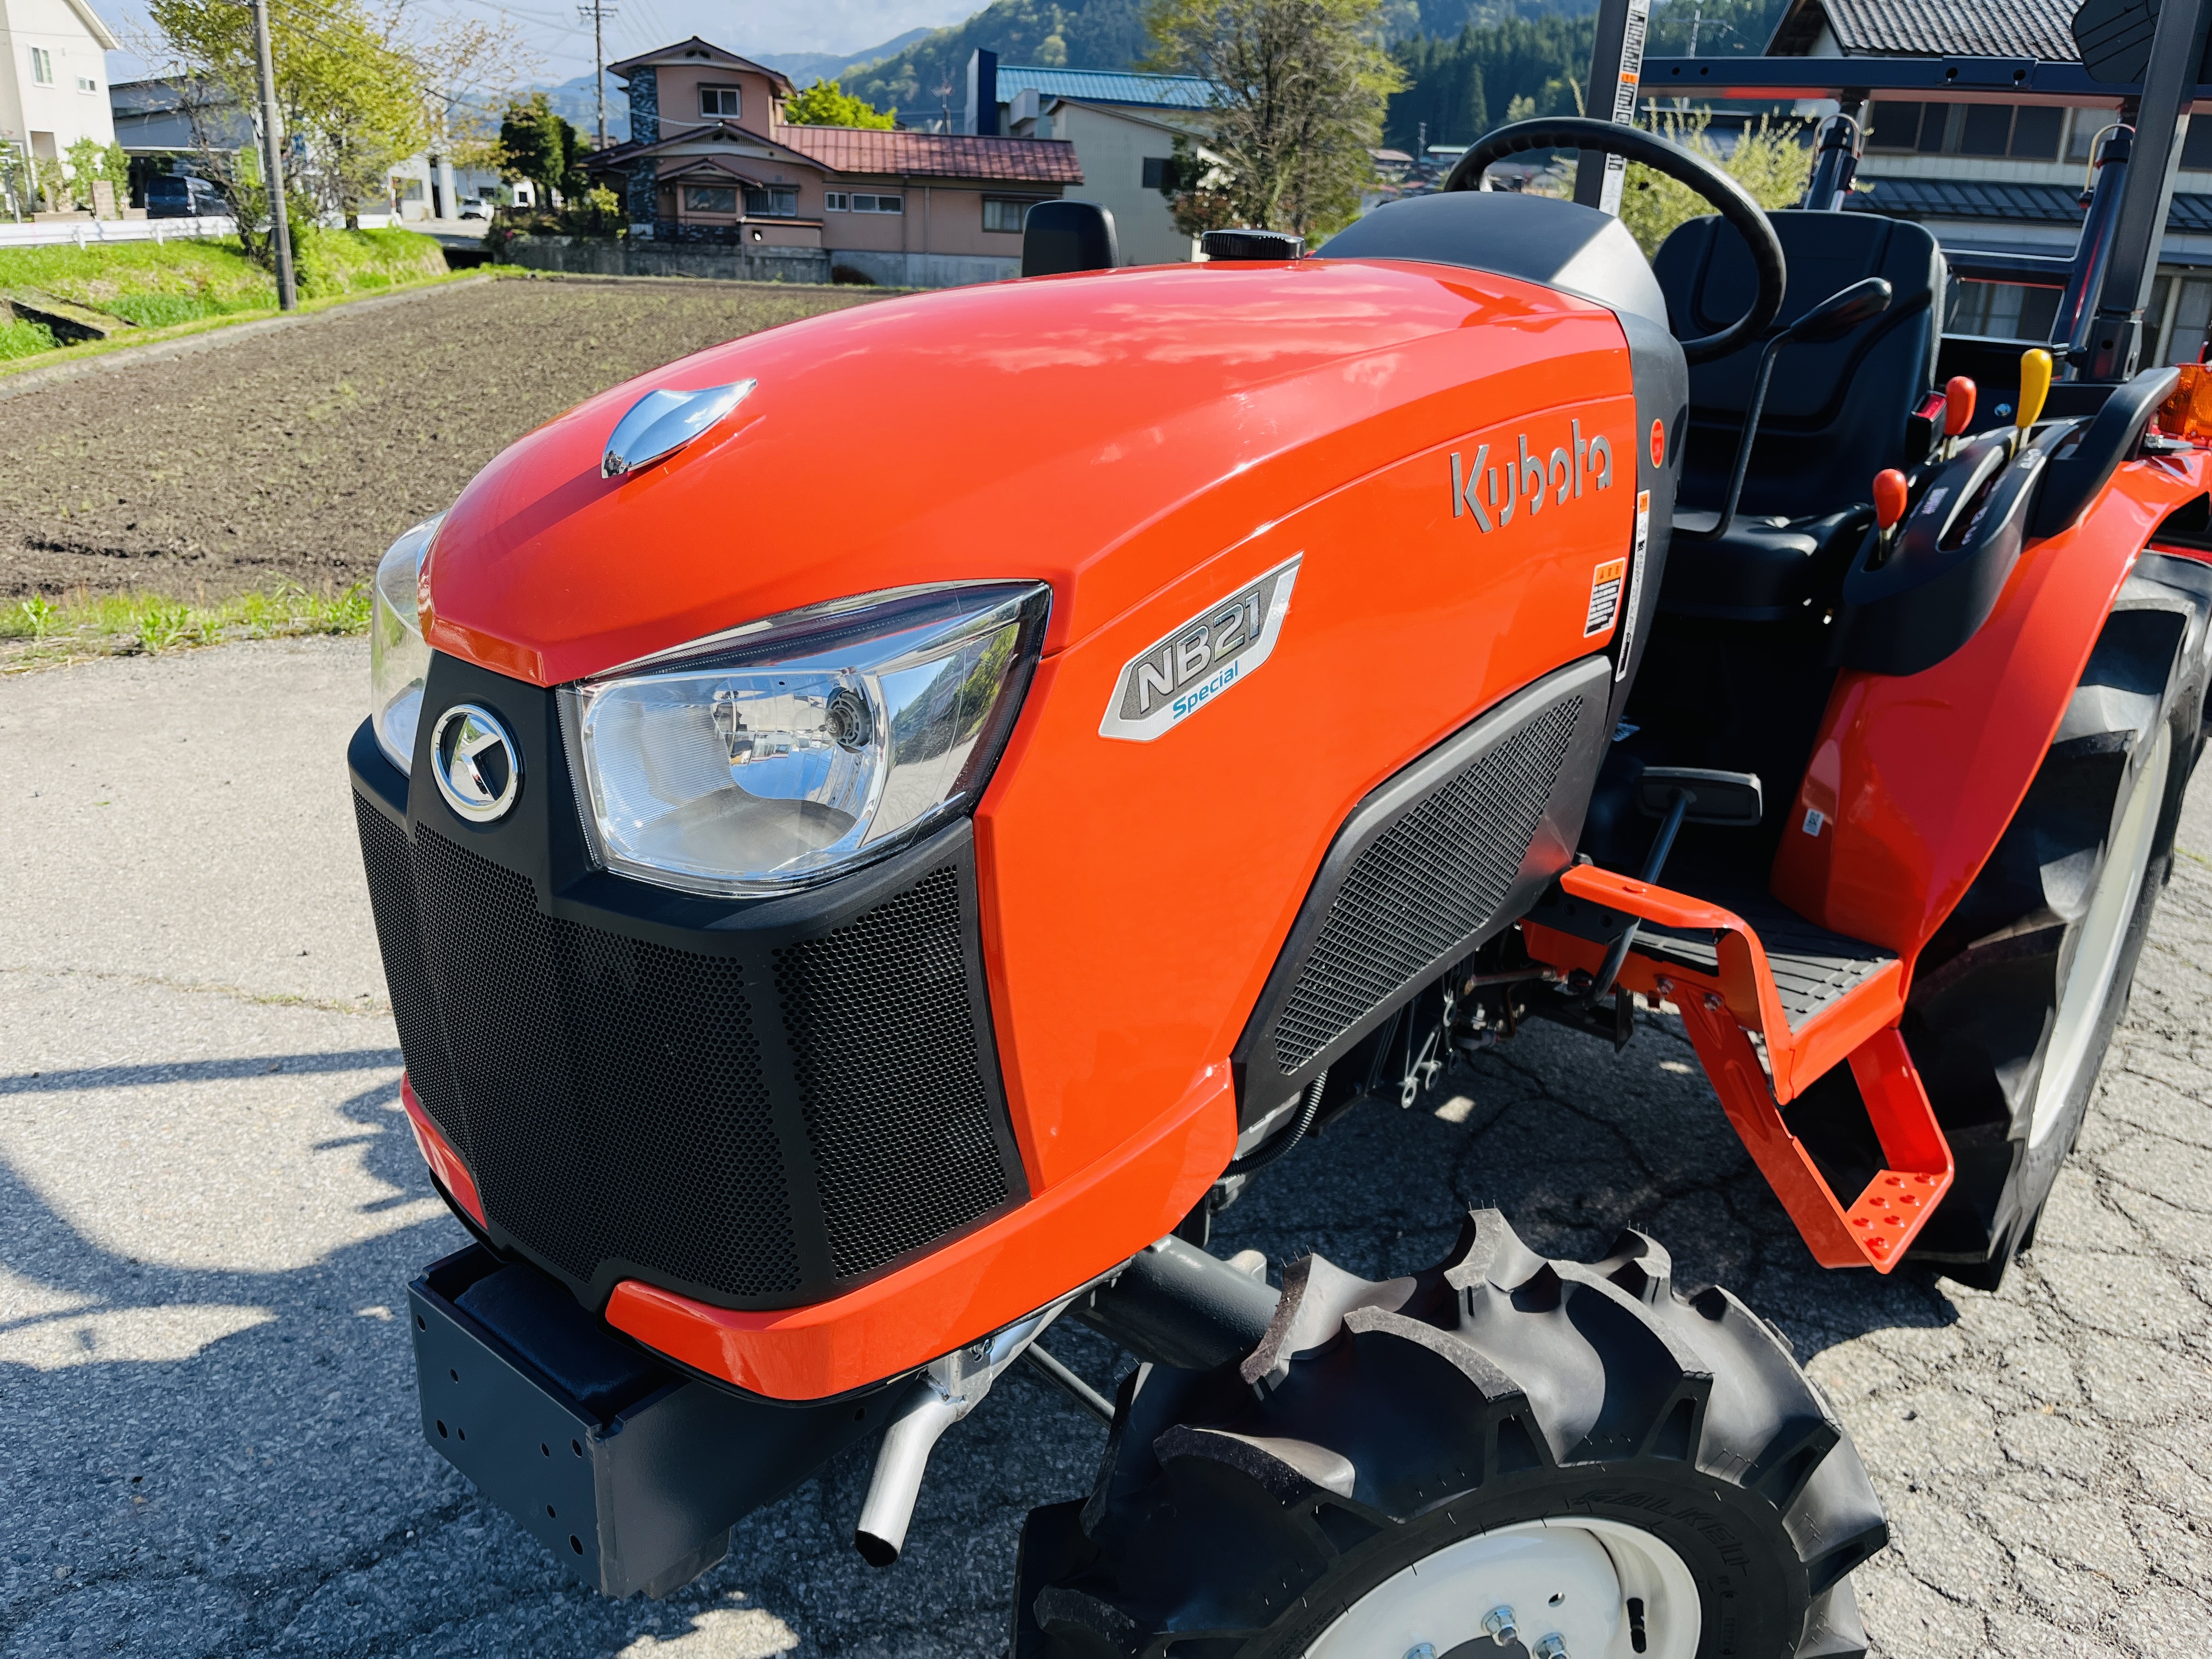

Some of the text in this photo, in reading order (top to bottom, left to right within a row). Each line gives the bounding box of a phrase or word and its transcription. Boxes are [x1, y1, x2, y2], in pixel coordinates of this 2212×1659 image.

[1450, 419, 1612, 534] Kubota
[1137, 591, 1261, 715] NB21
[1172, 661, 1239, 720] Special
